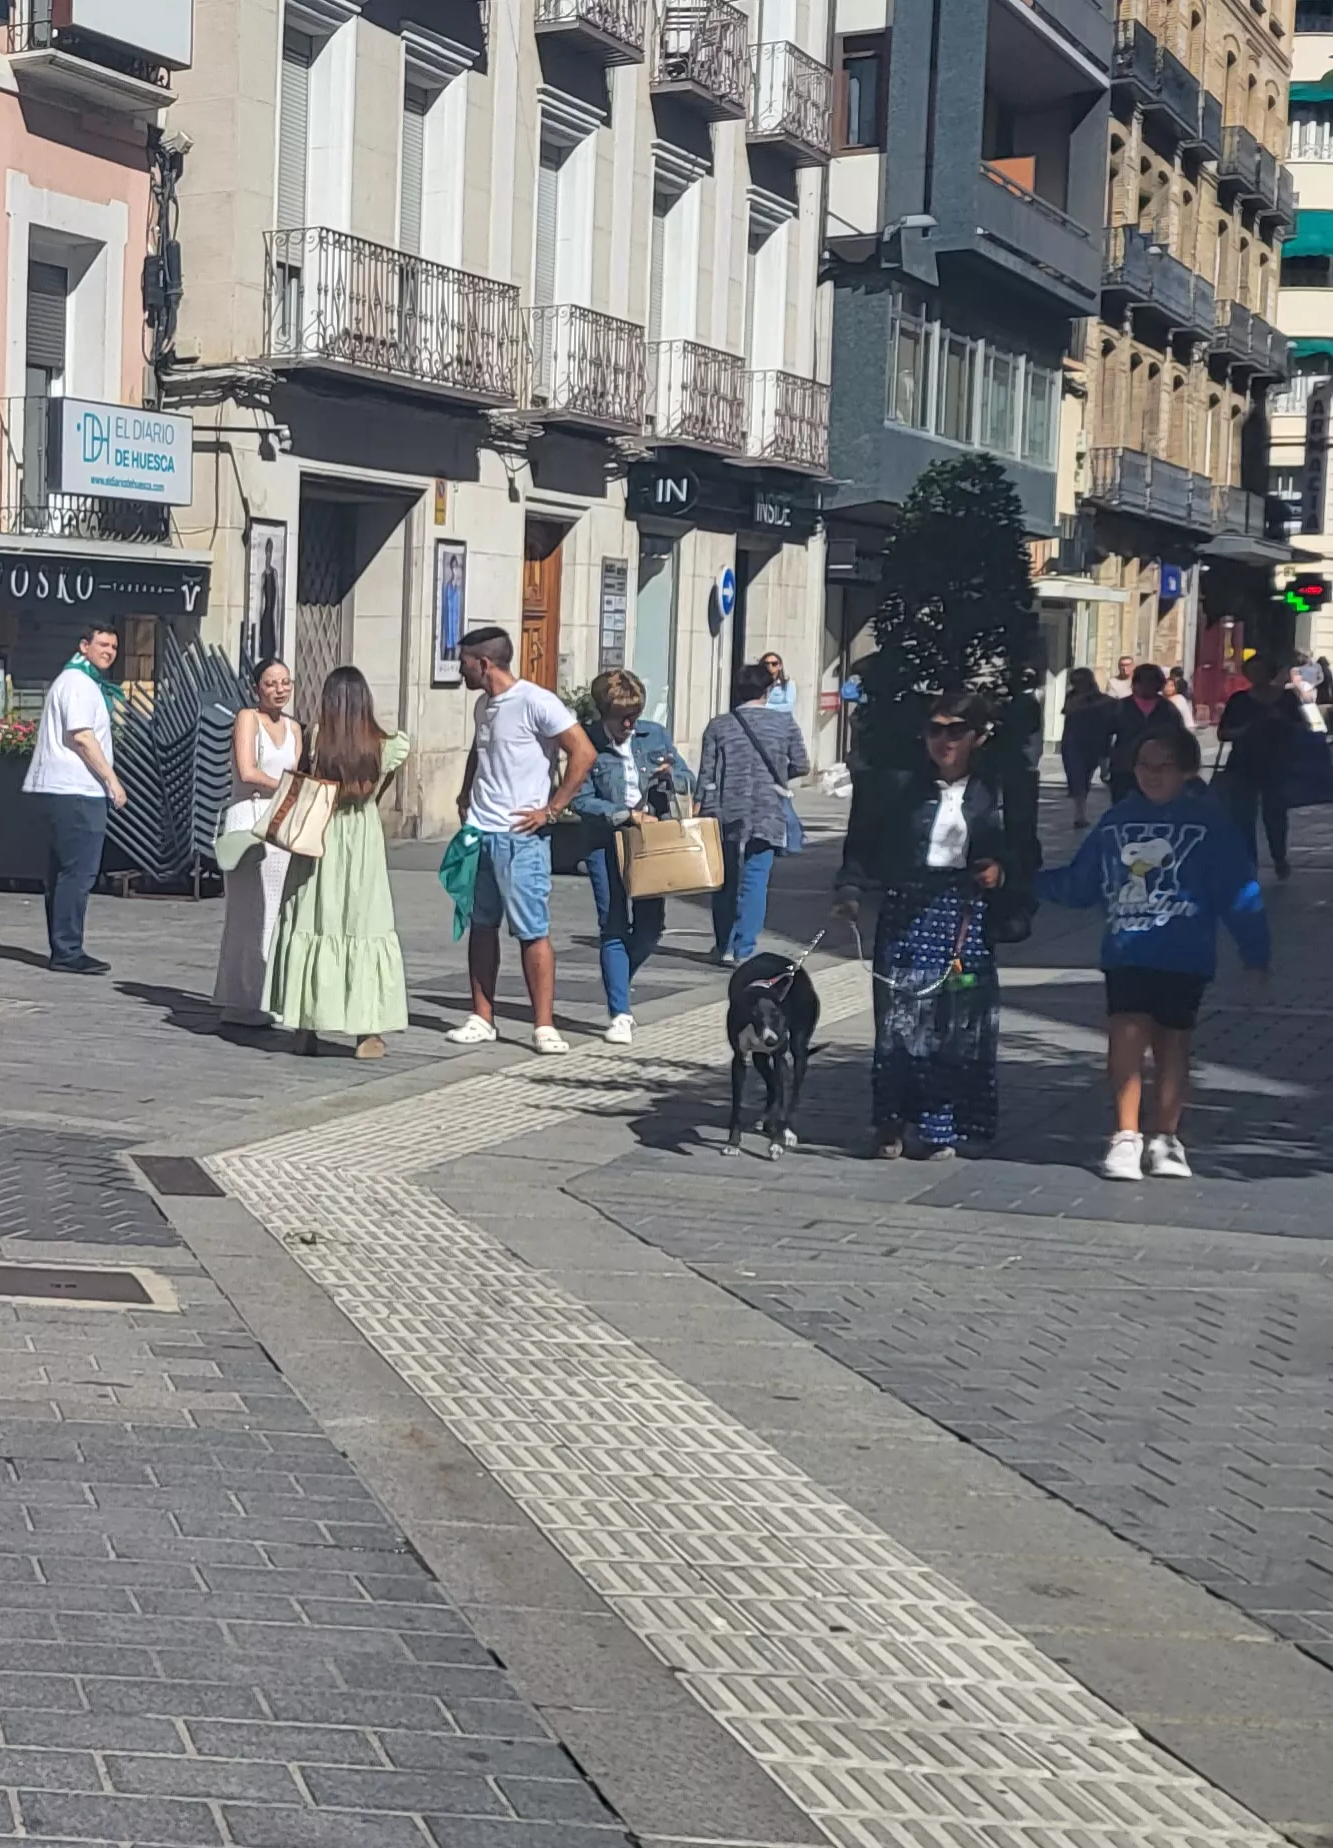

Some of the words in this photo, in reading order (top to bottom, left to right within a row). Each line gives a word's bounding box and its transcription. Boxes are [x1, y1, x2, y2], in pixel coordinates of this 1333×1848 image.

[116, 417, 130, 439] EL
[133, 419, 175, 445] DIARIO
[114, 448, 130, 467] DE
[132, 451, 175, 473] HUESCA
[656, 477, 688, 503] IN
[756, 492, 792, 527] INSIDE
